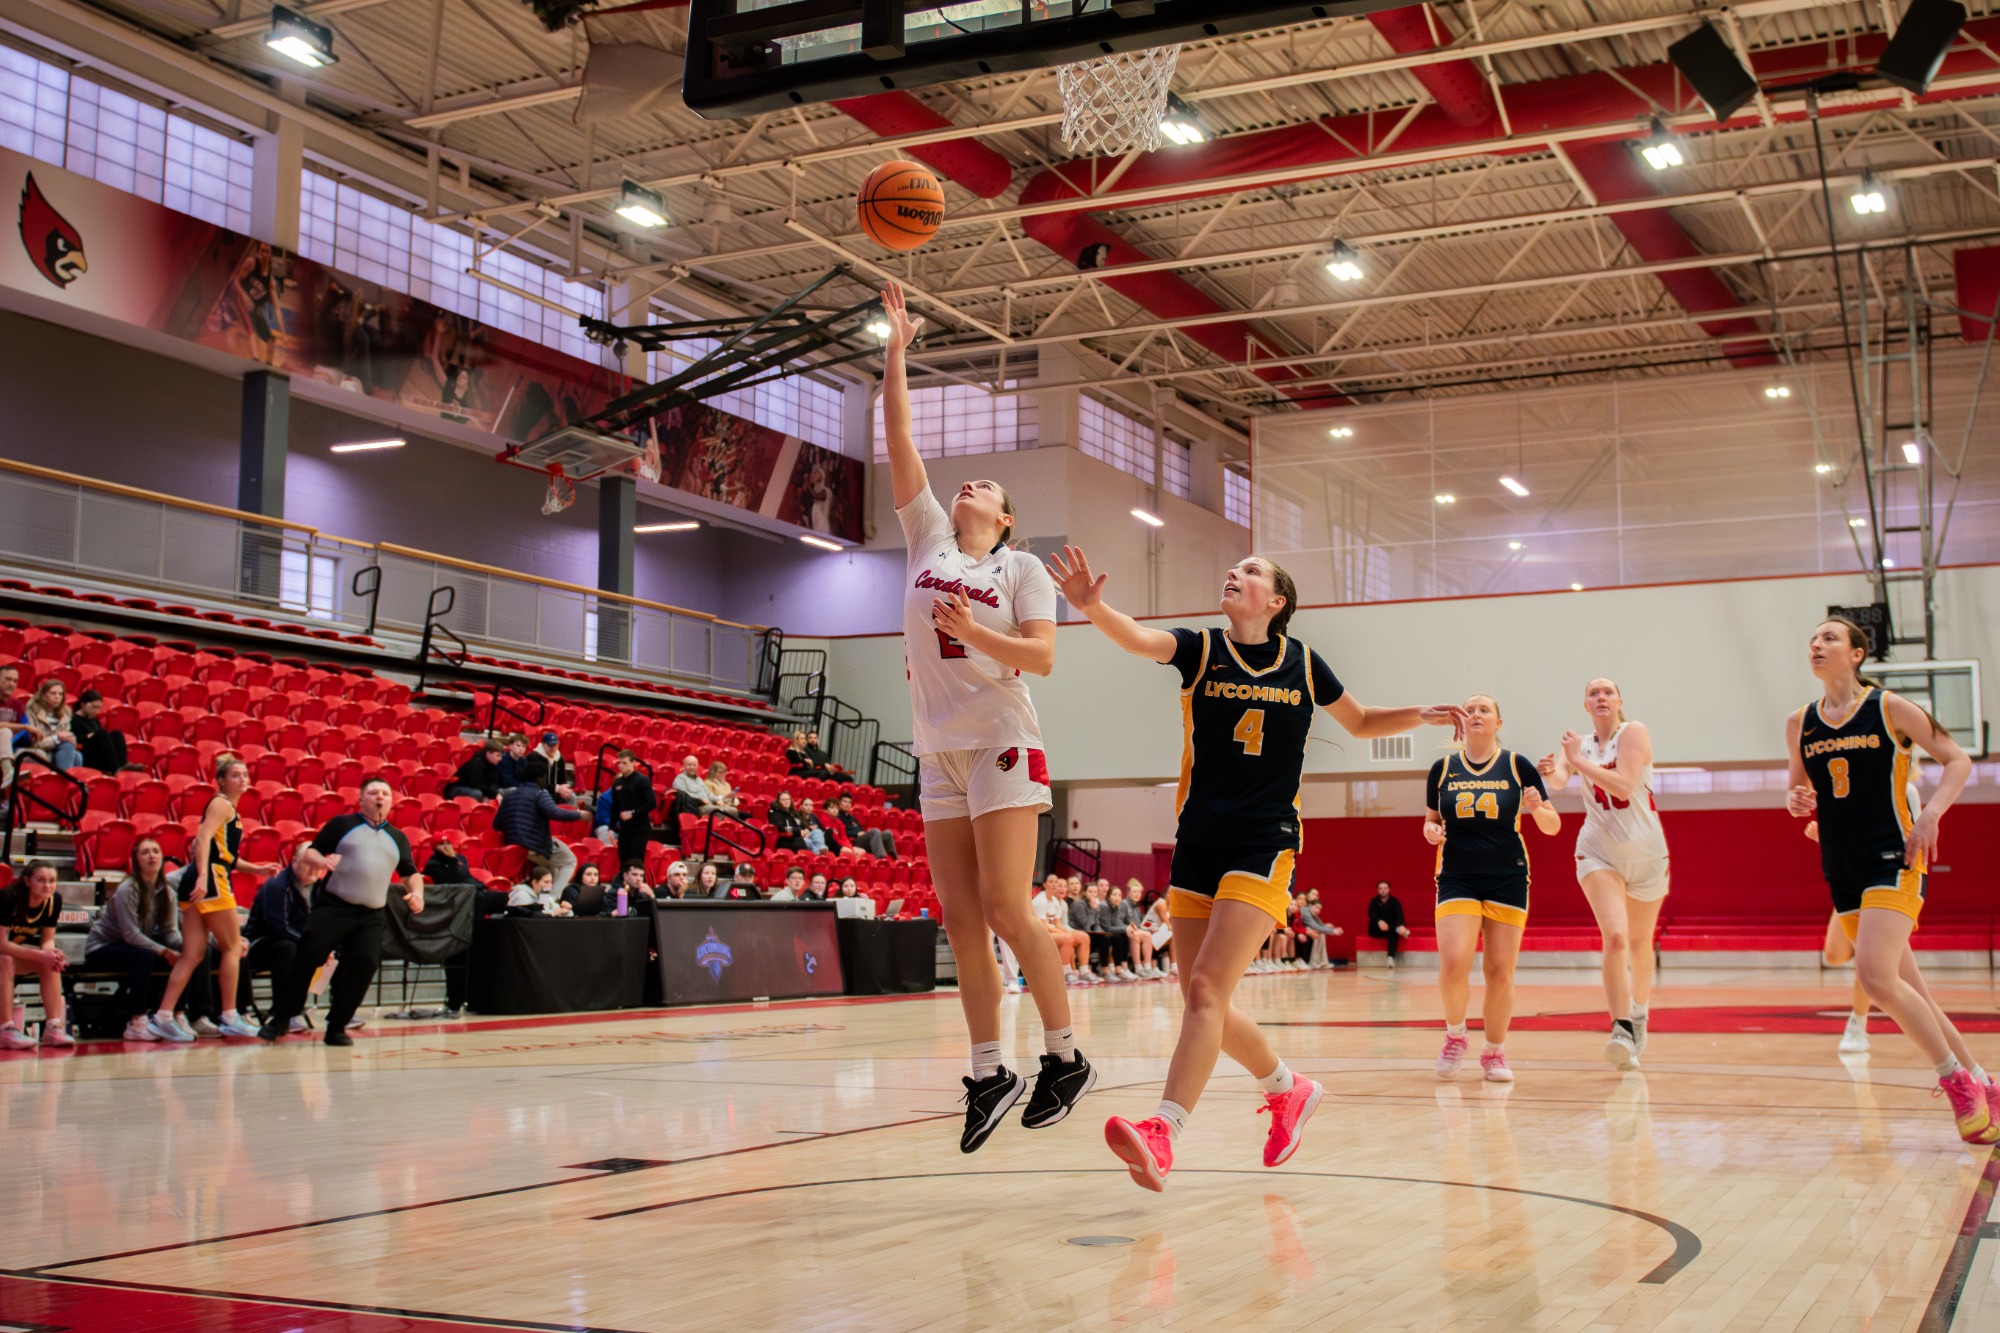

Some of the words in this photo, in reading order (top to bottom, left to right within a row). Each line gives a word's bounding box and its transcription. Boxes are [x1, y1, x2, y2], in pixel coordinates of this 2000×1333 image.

[1205, 681, 1302, 706] LYCOMING
[1233, 708, 1265, 756] 4
[1804, 734, 1880, 758] LYCOMING
[1448, 780, 1509, 791] LYCOMING
[1827, 757, 1850, 798] 8
[1455, 792, 1499, 819] 24
